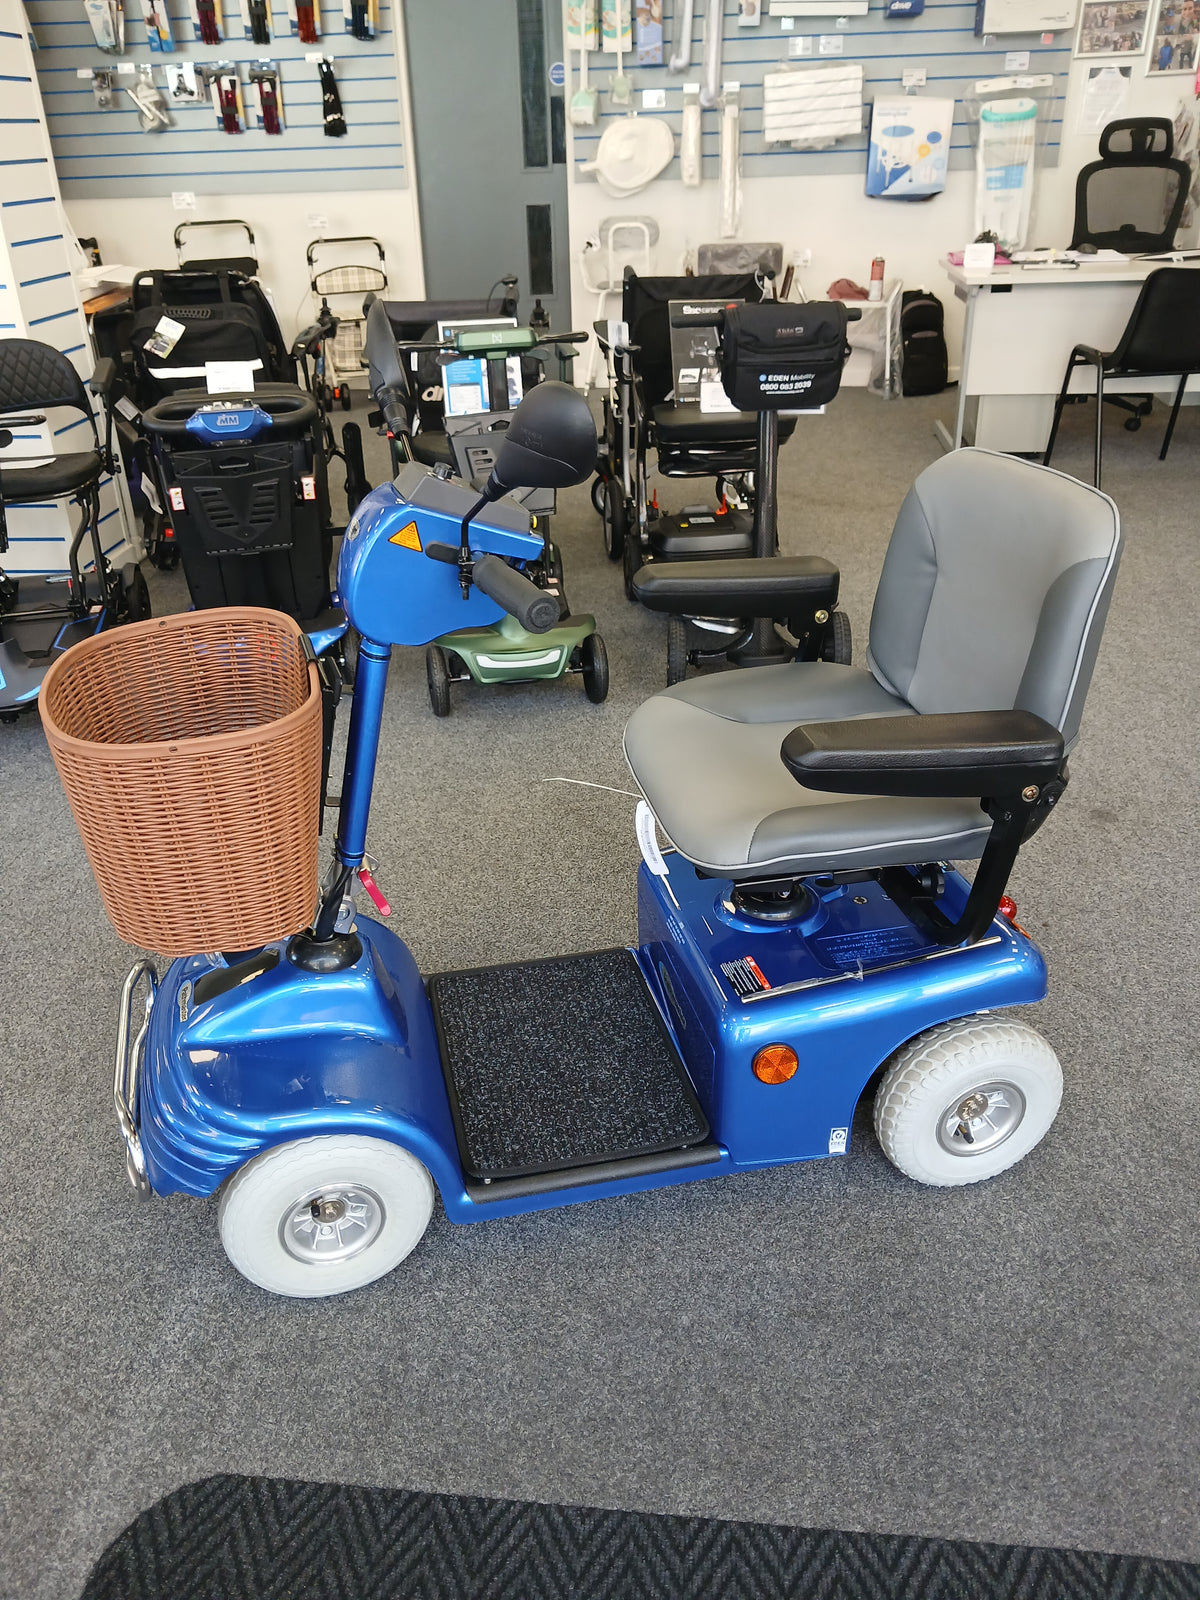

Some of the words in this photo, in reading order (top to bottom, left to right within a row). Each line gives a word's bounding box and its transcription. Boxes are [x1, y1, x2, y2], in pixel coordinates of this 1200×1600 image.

[768, 374, 790, 382] EDEN
[790, 373, 816, 381] Mobility
[760, 383, 779, 391] 0800
[794, 380, 812, 389] 2039
